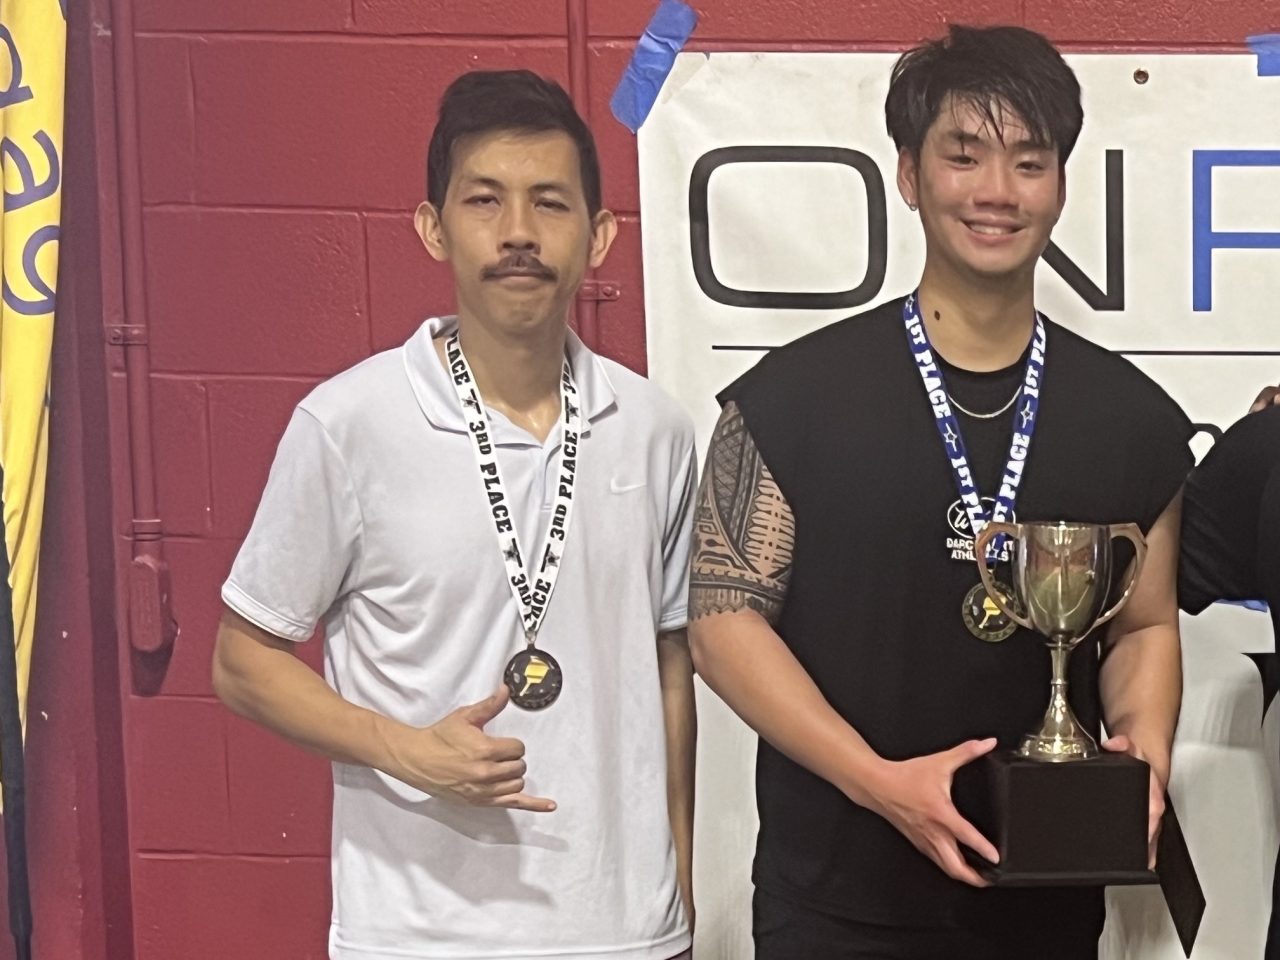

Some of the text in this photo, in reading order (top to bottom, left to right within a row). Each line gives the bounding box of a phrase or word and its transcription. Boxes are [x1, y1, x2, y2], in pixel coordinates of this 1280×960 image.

[905, 314, 952, 419] 1ST PLACE
[1024, 366, 1041, 398] 1ST
[469, 420, 513, 534] 3RD PLACE
[550, 431, 579, 541] 3RD PLACE
[951, 456, 974, 489] 1ST
[1000, 432, 1030, 500] PLACE
